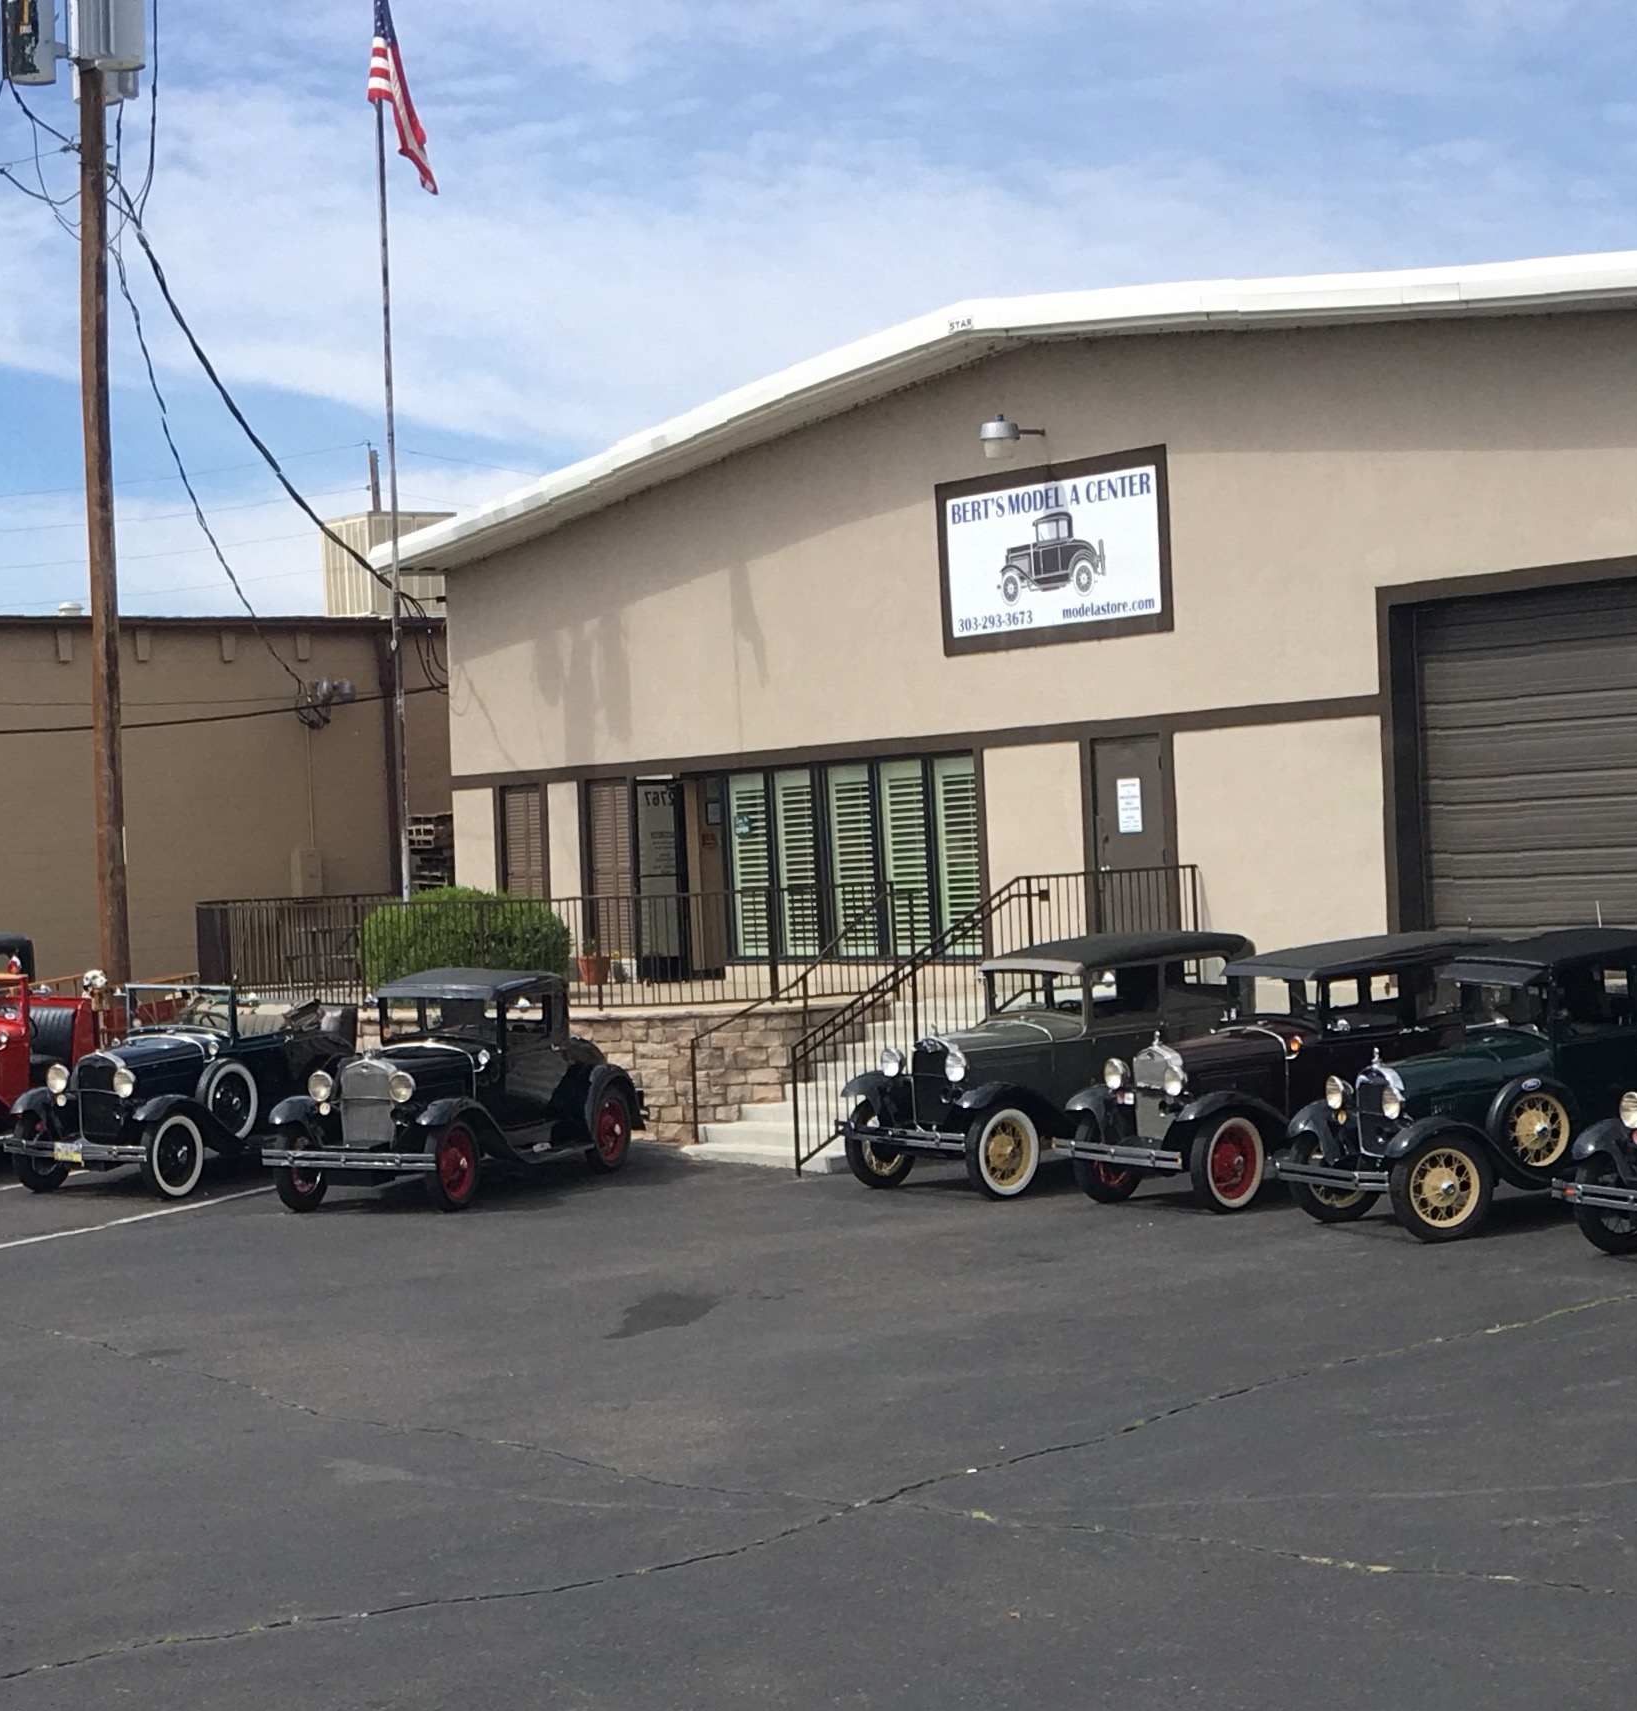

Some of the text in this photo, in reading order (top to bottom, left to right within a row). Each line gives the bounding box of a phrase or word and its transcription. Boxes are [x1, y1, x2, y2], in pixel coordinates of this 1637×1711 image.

[951, 472, 1151, 525] BERT'S MODEL A CENTER
[1063, 598, 1155, 619] modelastore.com
[958, 611, 1033, 633] 303-293-3673
